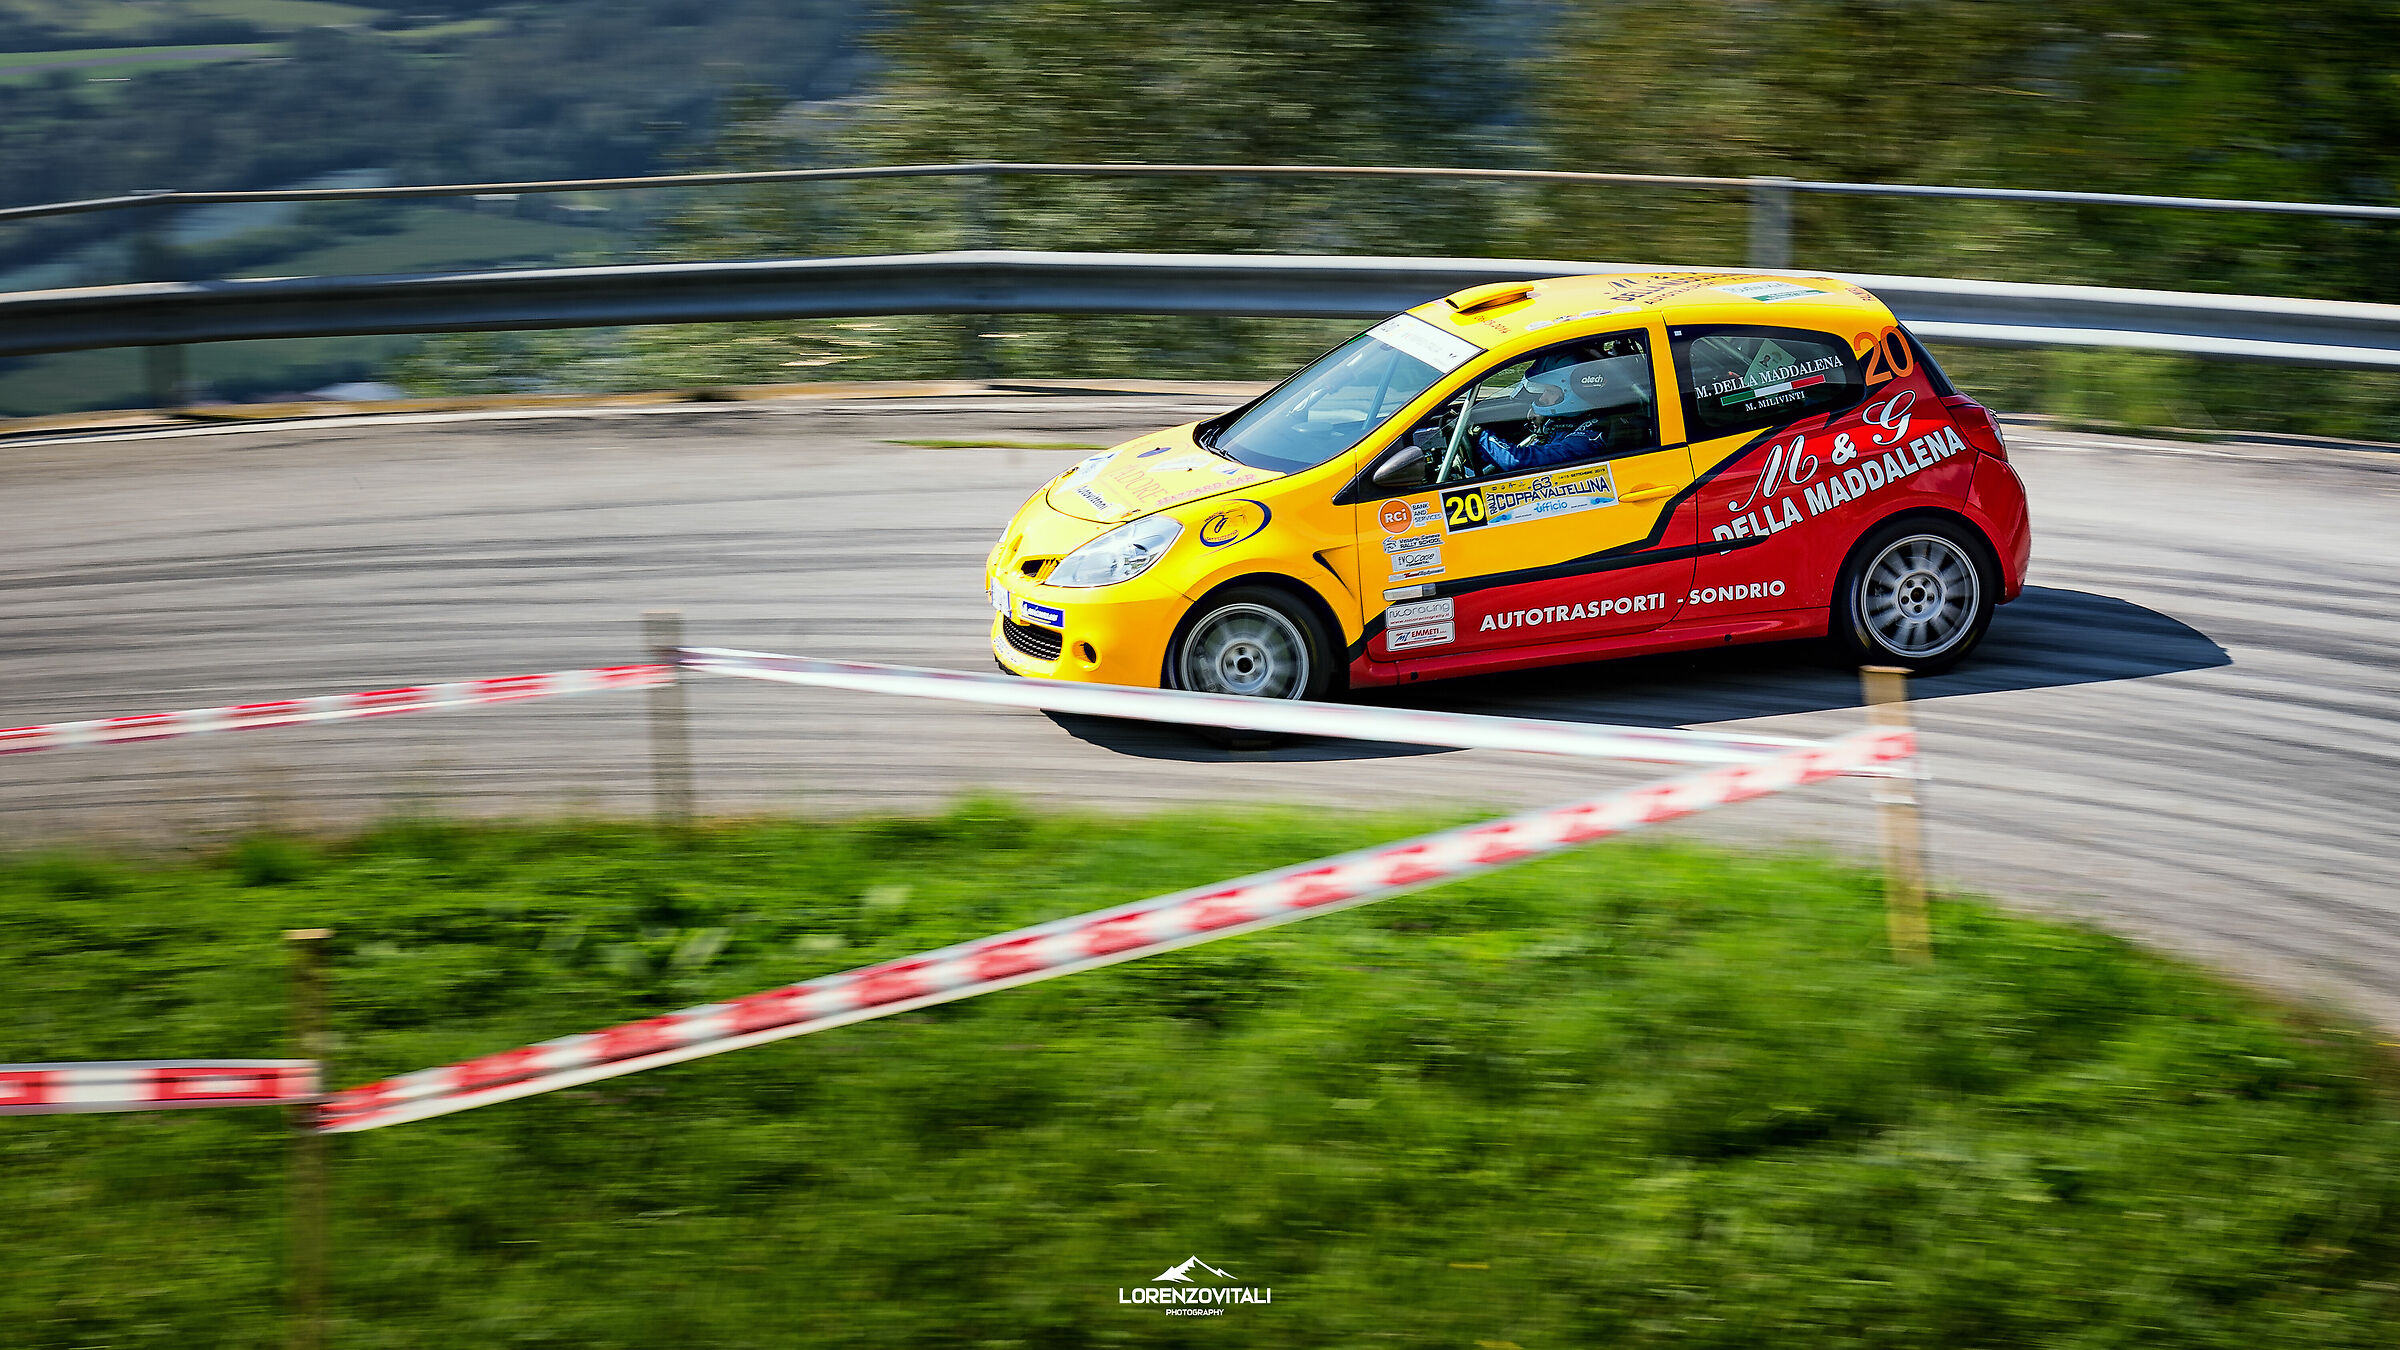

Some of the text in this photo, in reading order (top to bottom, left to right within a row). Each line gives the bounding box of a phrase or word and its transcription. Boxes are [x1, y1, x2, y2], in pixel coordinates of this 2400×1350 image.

[1853, 325, 1914, 387] 20
[1694, 355, 1844, 399] M. DELLA MADDALENA
[1745, 402, 1757, 411] M.
[1728, 390, 1917, 512] M & G
[1412, 502, 1429, 510] BANK
[1486, 493, 1499, 515] RALLY
[1496, 476, 1611, 511] COPPA VALTELLINA
[1711, 425, 1967, 555] DELLA MADDALENA
[1414, 513, 1442, 523] SERVICES
[1445, 493, 1485, 526] 20
[1389, 603, 1450, 618] nicoracing
[1480, 592, 1665, 632] AUTOTRASPORTI
[1689, 580, 1786, 605] SONDRIO
[1411, 628, 1439, 638] EMMETI
